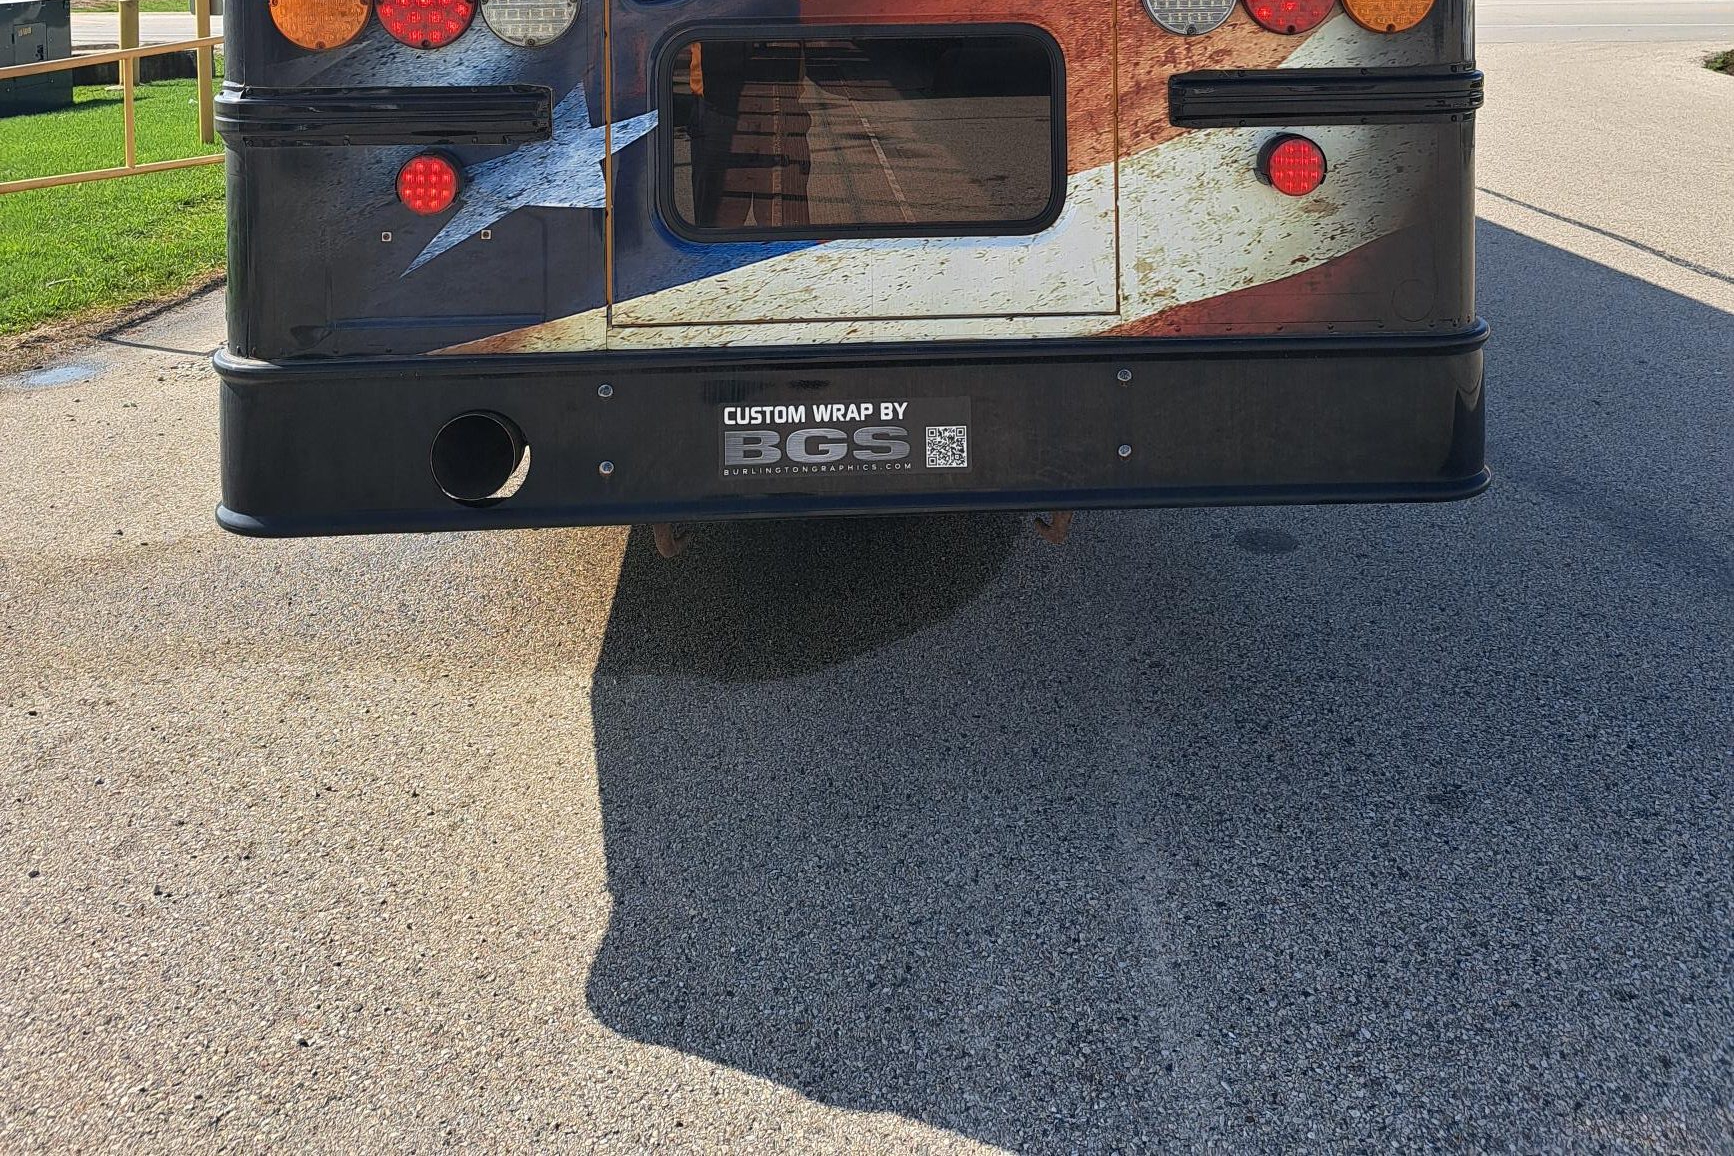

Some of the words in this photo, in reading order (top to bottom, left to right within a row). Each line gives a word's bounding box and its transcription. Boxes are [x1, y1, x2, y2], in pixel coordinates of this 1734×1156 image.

[723, 405, 806, 425] CUSTOM
[812, 403, 874, 423] WRAP
[880, 402, 909, 421] BY
[724, 426, 911, 466] BGS
[723, 463, 912, 476] BURLINGTONGRAPHICS.COM
